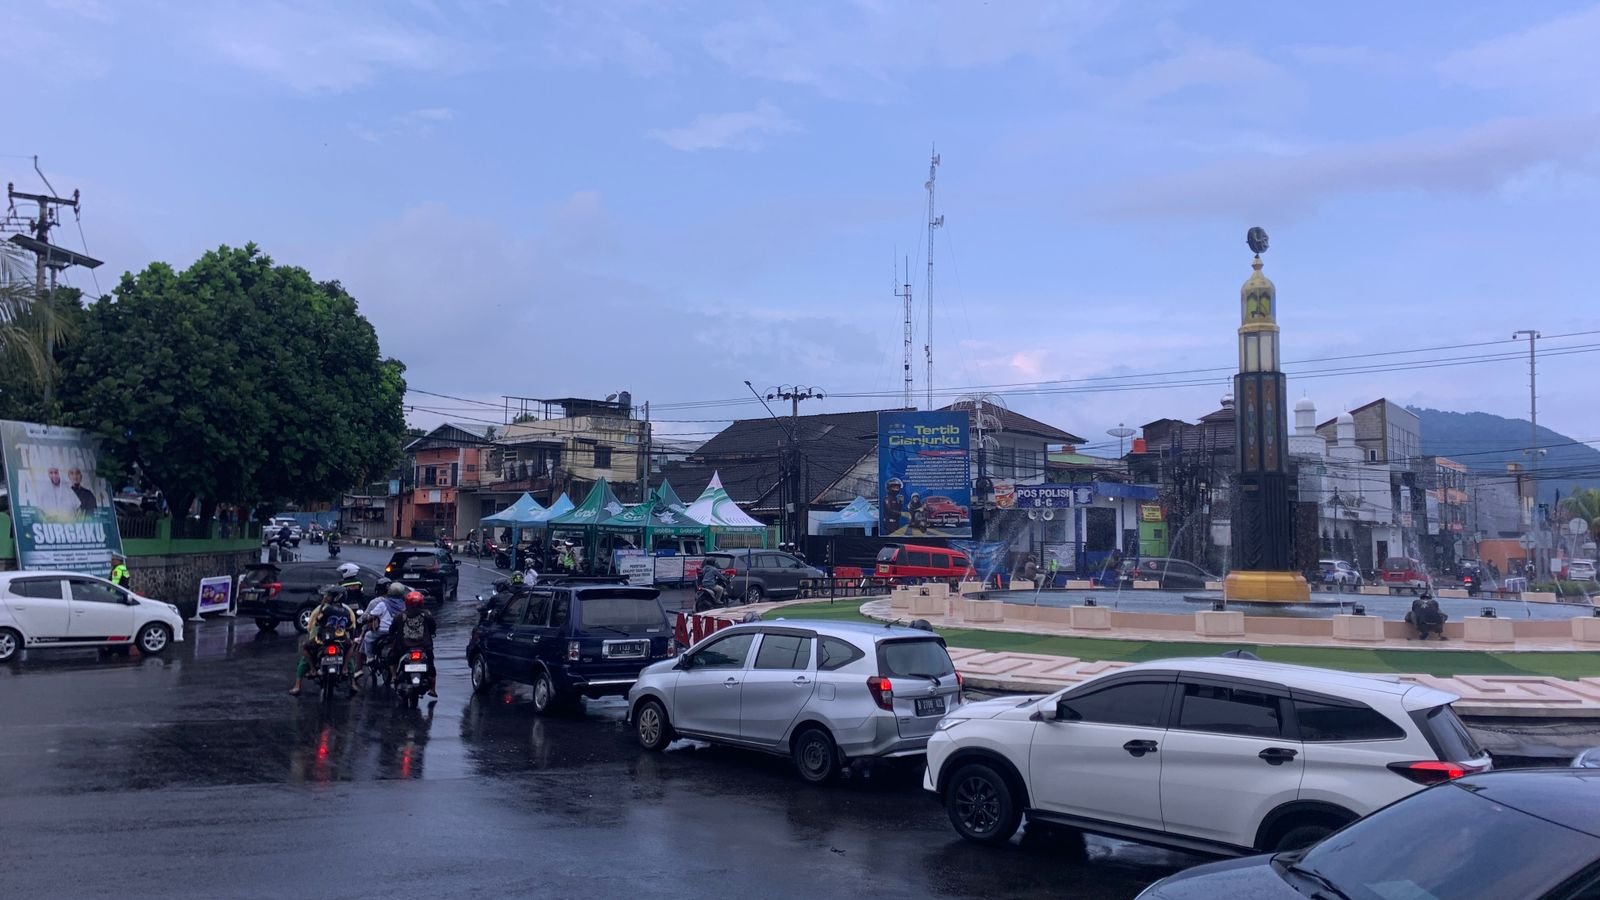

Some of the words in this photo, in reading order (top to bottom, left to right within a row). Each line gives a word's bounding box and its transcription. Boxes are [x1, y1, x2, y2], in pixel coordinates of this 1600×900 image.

[914, 425, 960, 435] Tertib
[888, 435, 960, 447] Cianjurku
[1017, 489, 1037, 498] POS
[1039, 489, 1069, 498] POLISI
[574, 508, 596, 518] Grab
[33, 522, 107, 544] SURGAKU
